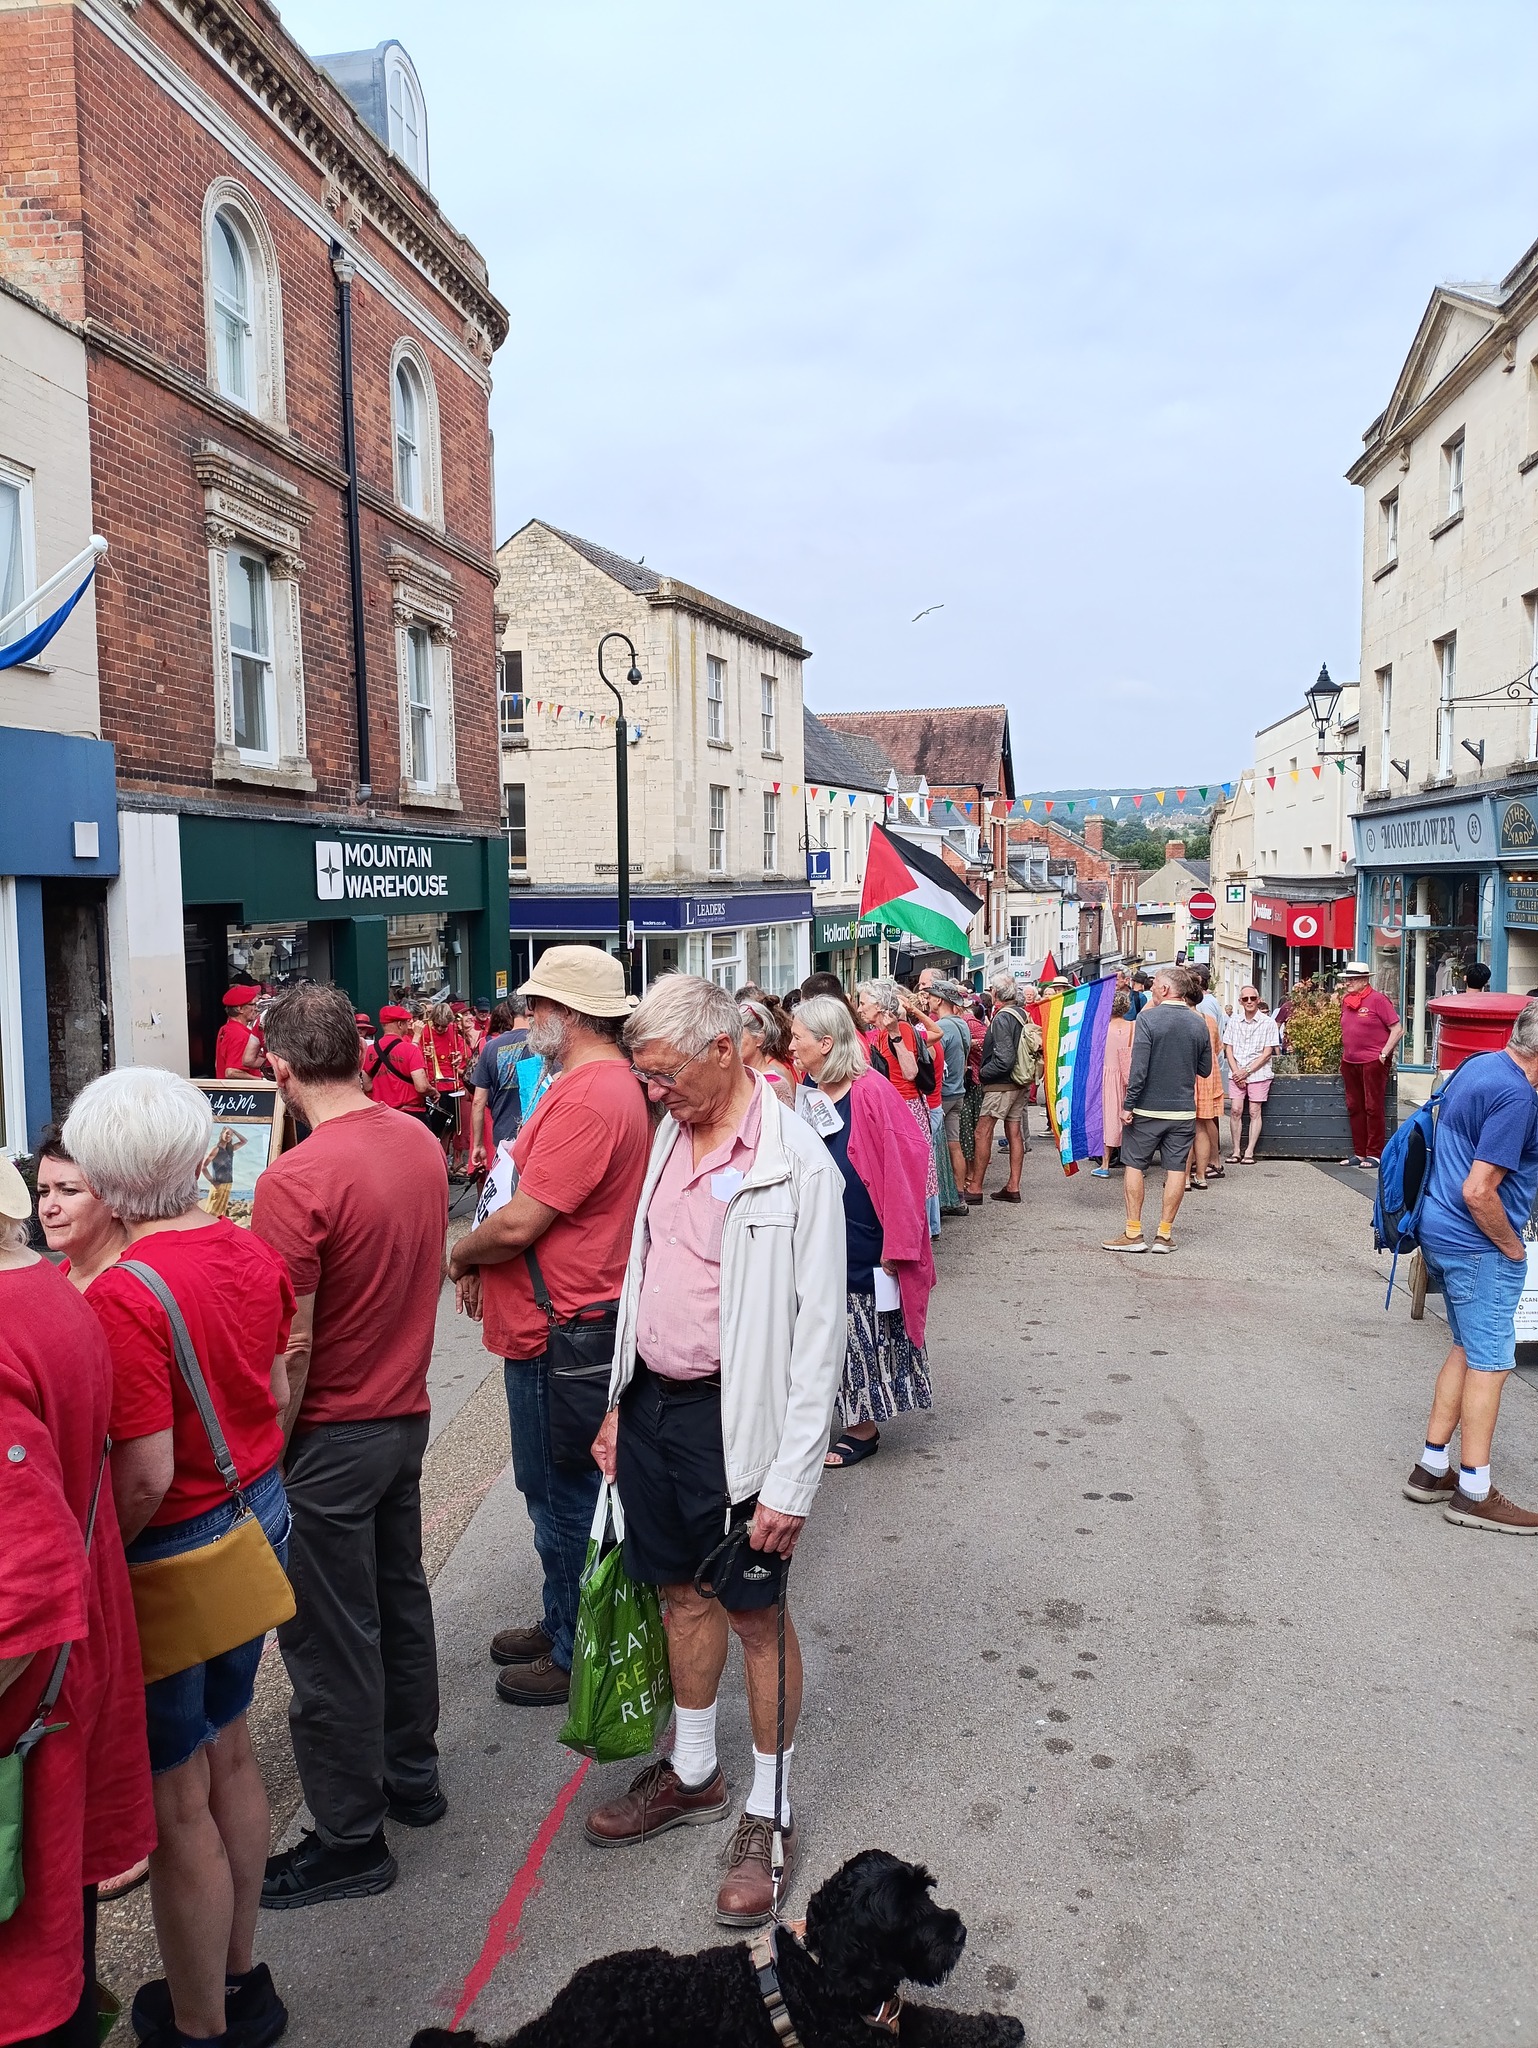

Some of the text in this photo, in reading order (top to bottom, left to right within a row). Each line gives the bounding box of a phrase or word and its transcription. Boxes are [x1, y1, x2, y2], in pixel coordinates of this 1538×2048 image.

[1470, 820, 1478, 836] 55
[1503, 806, 1536, 836] WITHEY'S
[1380, 815, 1461, 853] MOONFLOWER
[1510, 831, 1530, 845] YARD
[344, 842, 433, 868] MOUNTAIN
[344, 874, 449, 899] WAREHOUSE
[1509, 887, 1518, 897] THE
[1520, 888, 1534, 897] YARD
[697, 902, 726, 917] LEADERS
[1507, 912, 1526, 922] STROUD
[823, 921, 851, 944] Holland
[409, 944, 444, 971] FINAL
[410, 968, 445, 984] REDUCTIONS
[1055, 1000, 1086, 1152] PEACE
[484, 1176, 498, 1206] FOR
